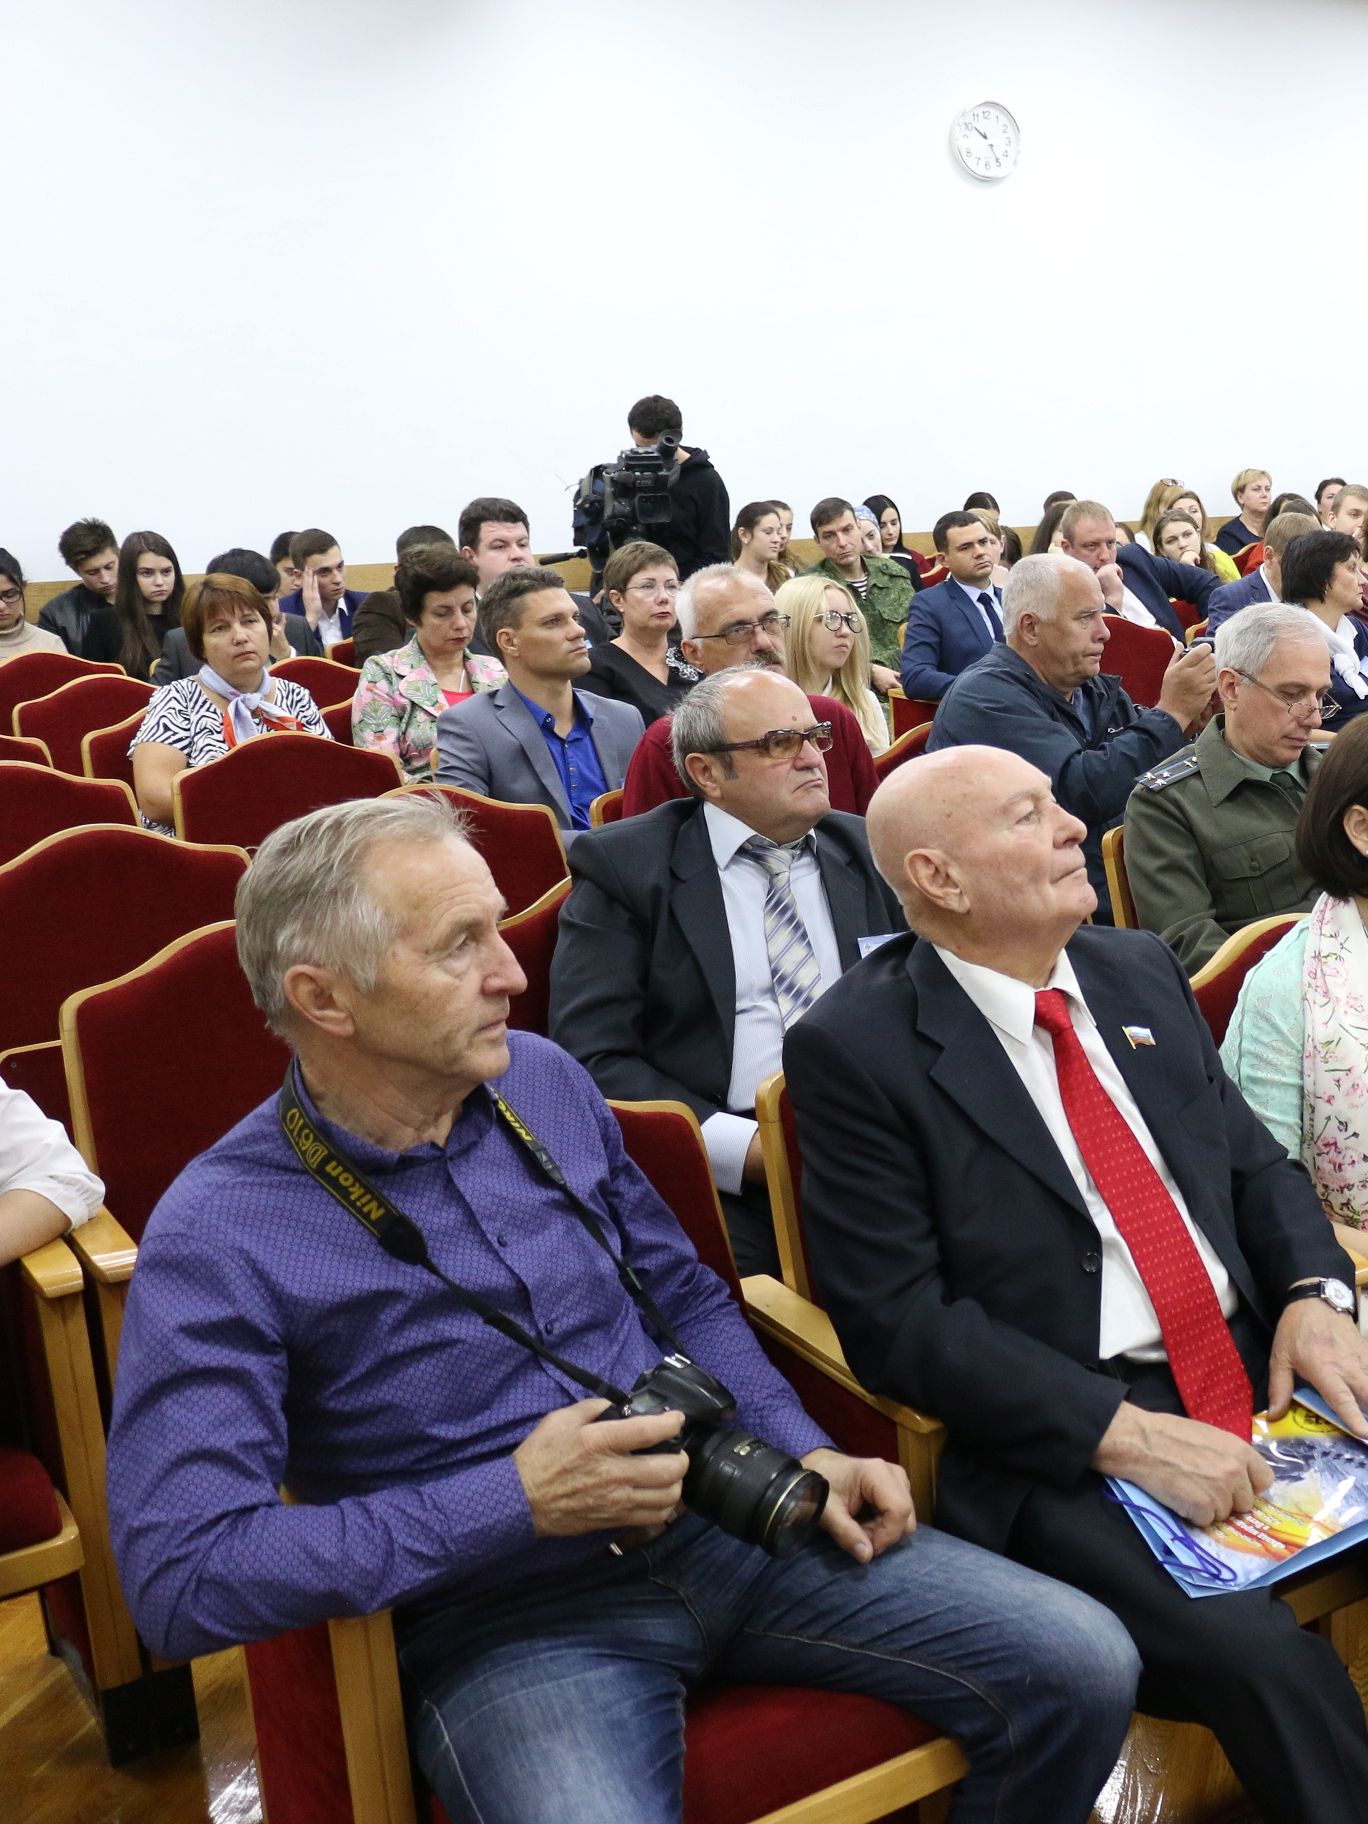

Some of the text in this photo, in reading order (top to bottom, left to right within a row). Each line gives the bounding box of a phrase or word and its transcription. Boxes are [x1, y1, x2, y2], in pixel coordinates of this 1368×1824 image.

[497, 1099, 533, 1142] Niko
[286, 1108, 386, 1221] Nikon D610
